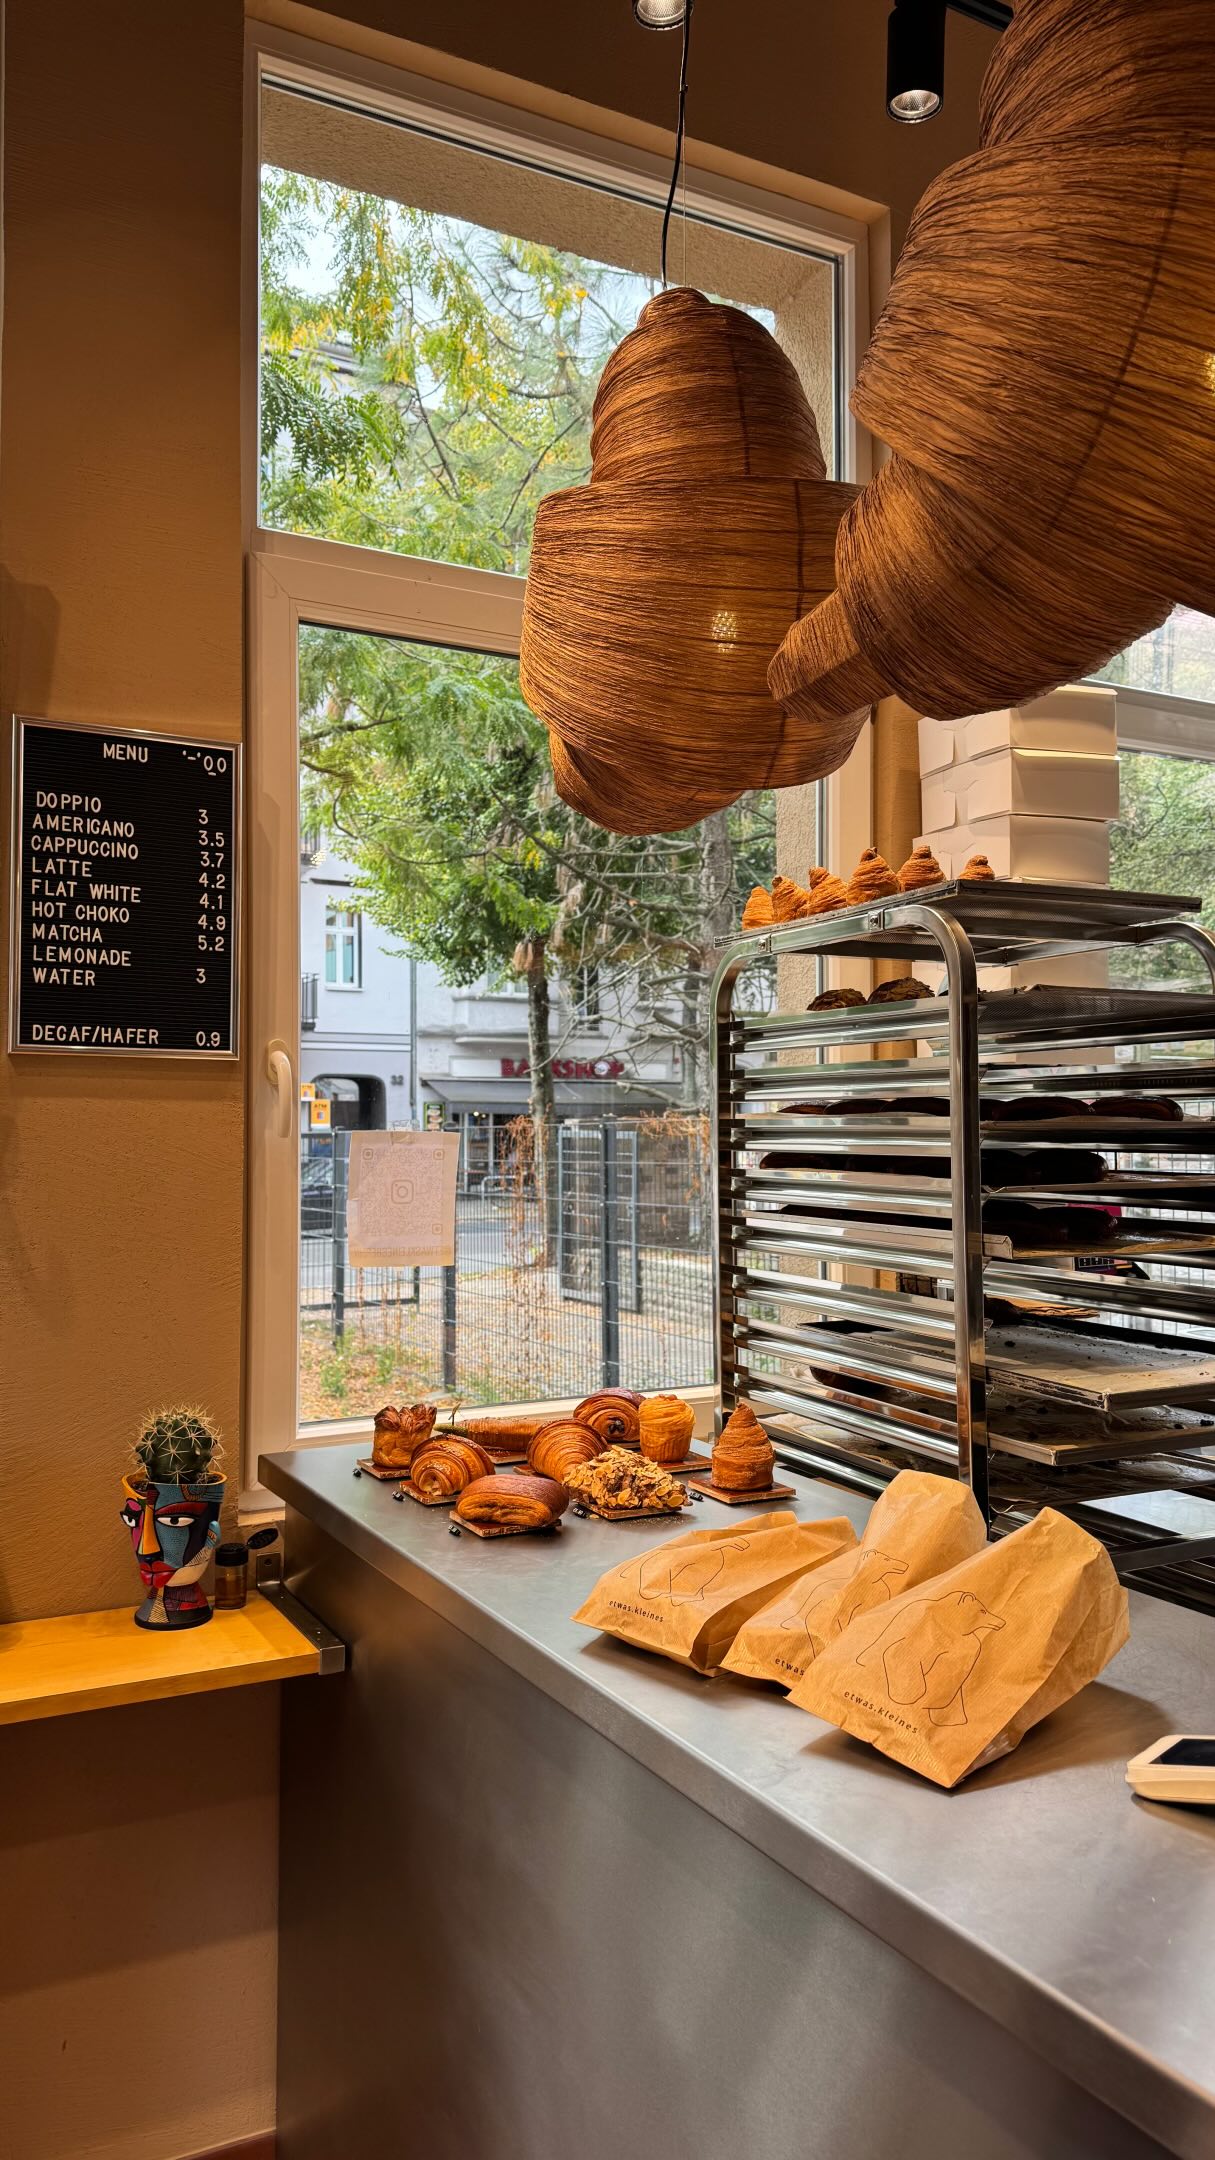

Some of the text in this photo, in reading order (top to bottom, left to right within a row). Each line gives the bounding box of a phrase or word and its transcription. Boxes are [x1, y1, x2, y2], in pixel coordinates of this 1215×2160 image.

[104, 743, 148, 762] MENU
[37, 791, 208, 824] DOPPIO 3
[199, 830, 224, 847] 3.5
[31, 835, 224, 868] CAPPUCCINO 3.7
[33, 857, 225, 888] LATTE 4.2
[32, 879, 222, 909] FLAT WHITE 4.1
[33, 901, 225, 930] HOT CHOKO 4.9
[33, 923, 224, 951] MATCHA 5.2
[34, 945, 131, 966] LEMONADE
[33, 968, 206, 986] WATER 3
[195, 1031, 222, 1047] 0.9
[501, 1058, 624, 1078] BAKSHOP
[609, 1600, 664, 1622] etwas.kleines
[844, 1690, 918, 1734] etwas.kleines
